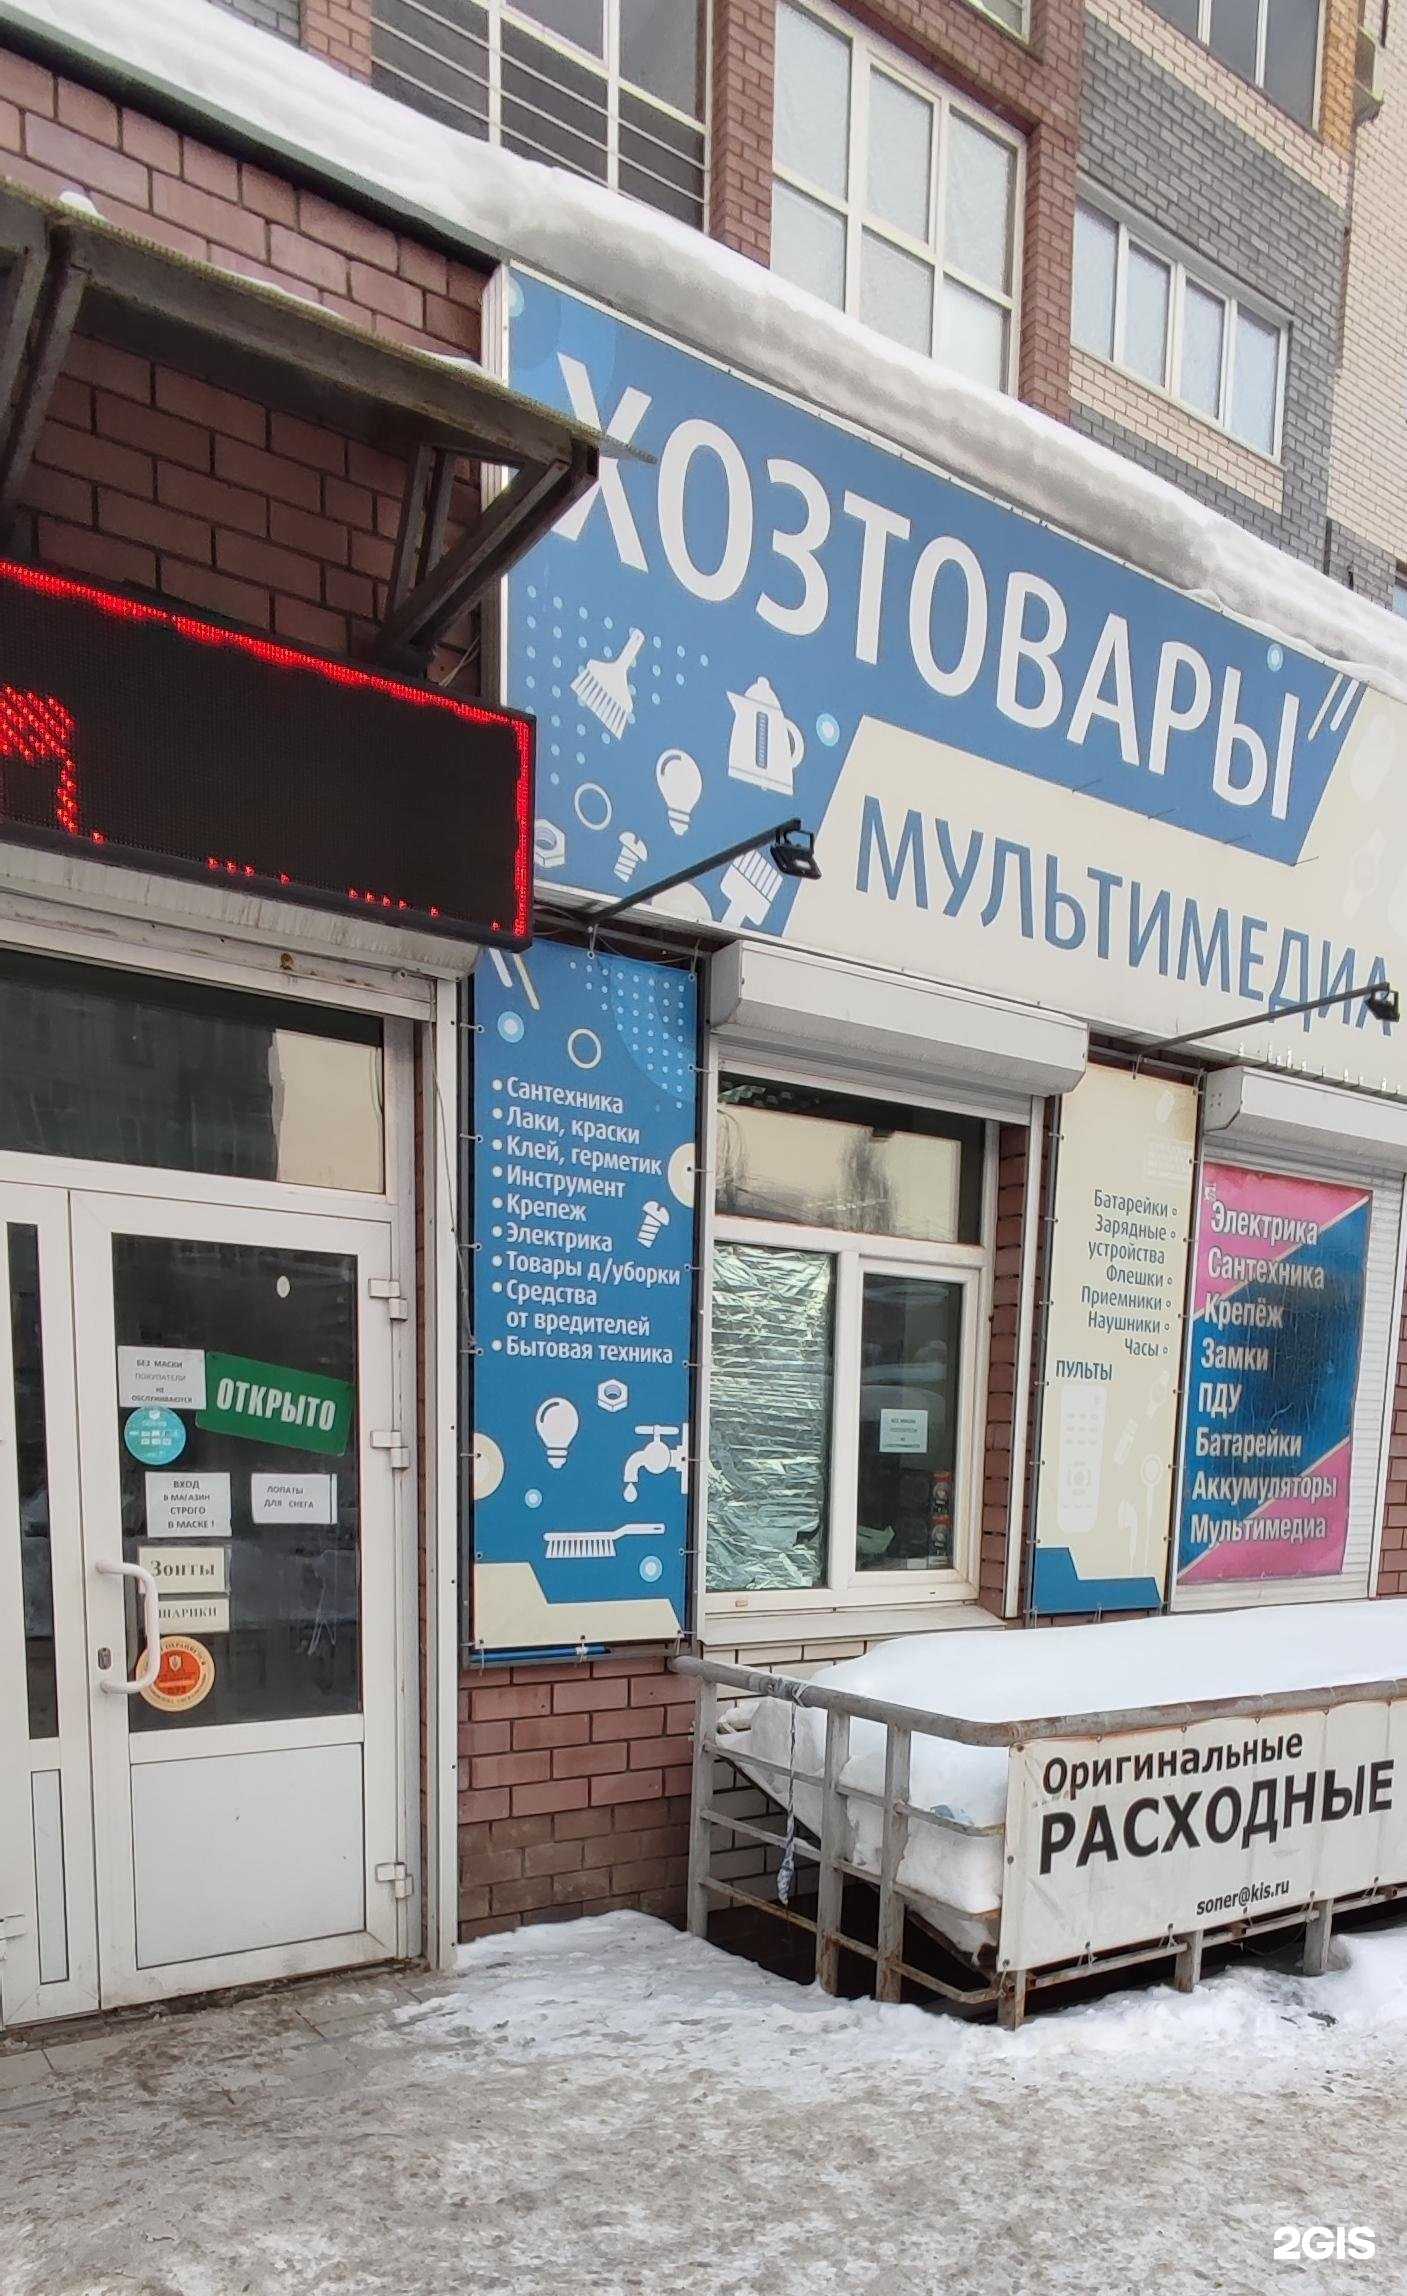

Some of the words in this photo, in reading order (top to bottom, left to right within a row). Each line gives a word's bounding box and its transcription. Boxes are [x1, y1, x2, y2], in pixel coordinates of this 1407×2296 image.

[551, 353, 1300, 821] ХОЗТОВАРЫ
[855, 795, 1391, 1036] МУЛЬТИМЕДИА
[507, 1076, 624, 1114] Сантехника
[506, 1107, 564, 1137] Лаки,
[571, 1121, 640, 1144] краски
[507, 1136, 565, 1167] Клей,
[571, 1148, 664, 1177] герметик
[507, 1165, 625, 1199] Инструмент
[507, 1193, 588, 1222] Крепеж
[1094, 1189, 1168, 1217] Батарейки
[507, 1222, 613, 1252] Электрика
[1095, 1215, 1167, 1240] Зарядные
[1210, 1200, 1319, 1247] Электрика
[507, 1251, 582, 1279] Товары
[587, 1257, 680, 1286] д/уборки
[1088, 1241, 1165, 1264] устройства
[1208, 1246, 1325, 1290] Сантехника
[1106, 1264, 1163, 1287] Флешки
[507, 1279, 597, 1306] Средства
[1081, 1285, 1162, 1311] Приемники
[507, 1310, 528, 1328] от
[534, 1312, 650, 1336] вредителей
[1088, 1311, 1160, 1334] Наушники
[1204, 1292, 1284, 1332] Крепёж
[506, 1335, 593, 1361] Бытовая
[598, 1343, 673, 1365] техника
[1124, 1337, 1159, 1357] Часы
[1201, 1337, 1269, 1372] Замки
[216, 1378, 336, 1431] ОТКРЫТО
[1199, 1381, 1243, 1418] ПДУ
[1196, 1427, 1303, 1461] Батарейки
[170, 1493, 210, 1501] МАГАЗИН
[173, 1480, 200, 1490] ВХОД
[266, 1485, 304, 1495] ЛОПАТЫ
[1192, 1471, 1337, 1505] Аккумуляторы
[170, 1506, 206, 1515] СТРОГО
[263, 1499, 283, 1508] ДЛЯ
[288, 1500, 314, 1509] СНЕГА
[168, 1521, 175, 1529] В
[1190, 1513, 1326, 1548] Мультимедиа
[150, 1560, 215, 1577] Зонты
[1042, 1732, 1304, 1800] Оригинальные
[1039, 1758, 1395, 1875] РАСХОДНЫЕ
[1196, 1878, 1290, 1916] soner@kis.ru
